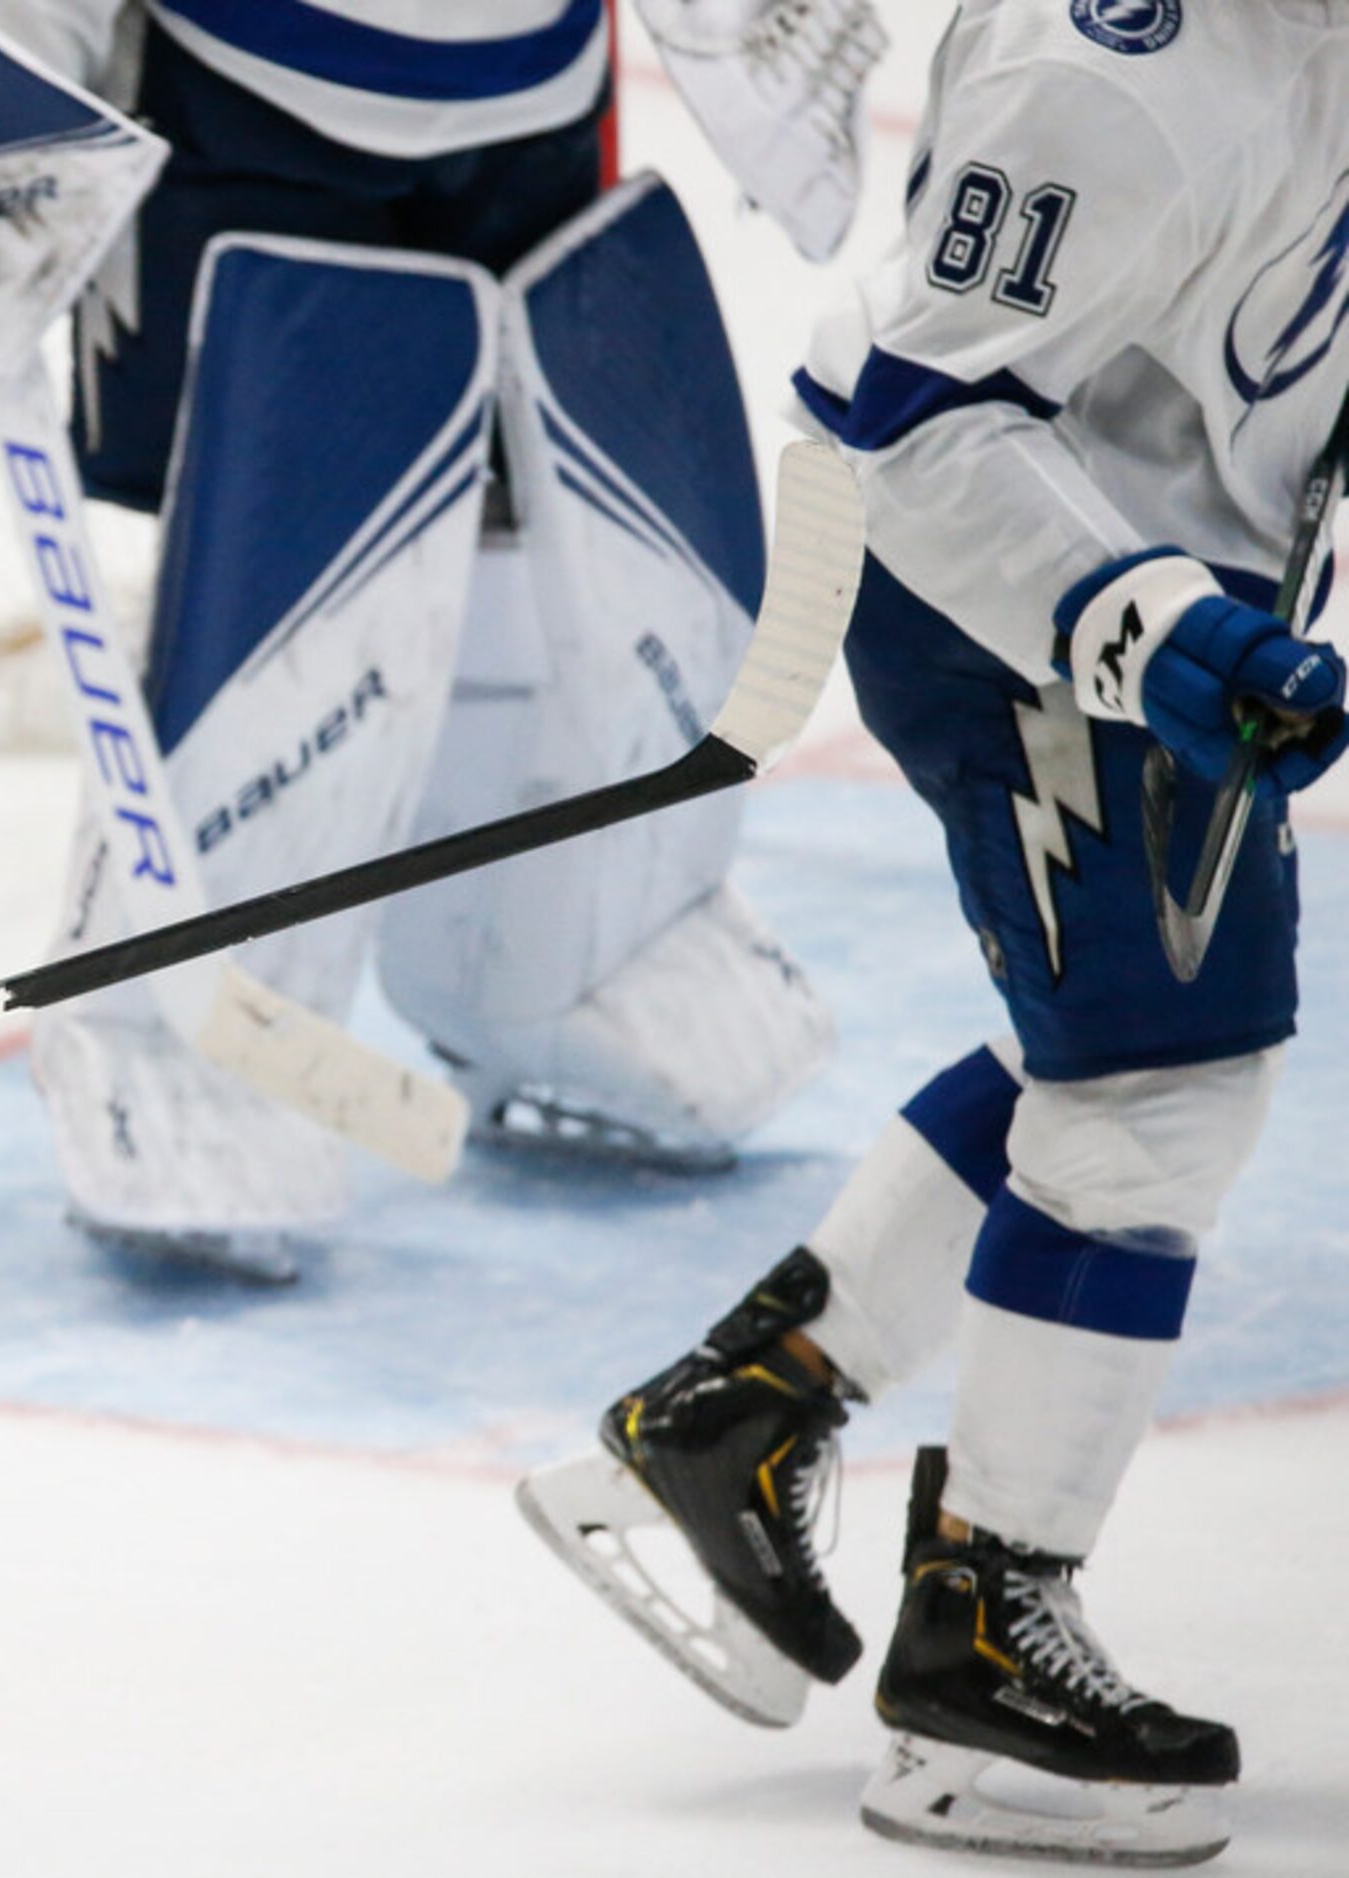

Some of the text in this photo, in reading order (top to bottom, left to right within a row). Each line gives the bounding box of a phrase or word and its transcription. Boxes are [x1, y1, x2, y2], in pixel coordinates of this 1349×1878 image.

[925, 160, 1077, 318] 81
[5, 441, 177, 887] BAUER
[195, 667, 388, 855] BAUER
